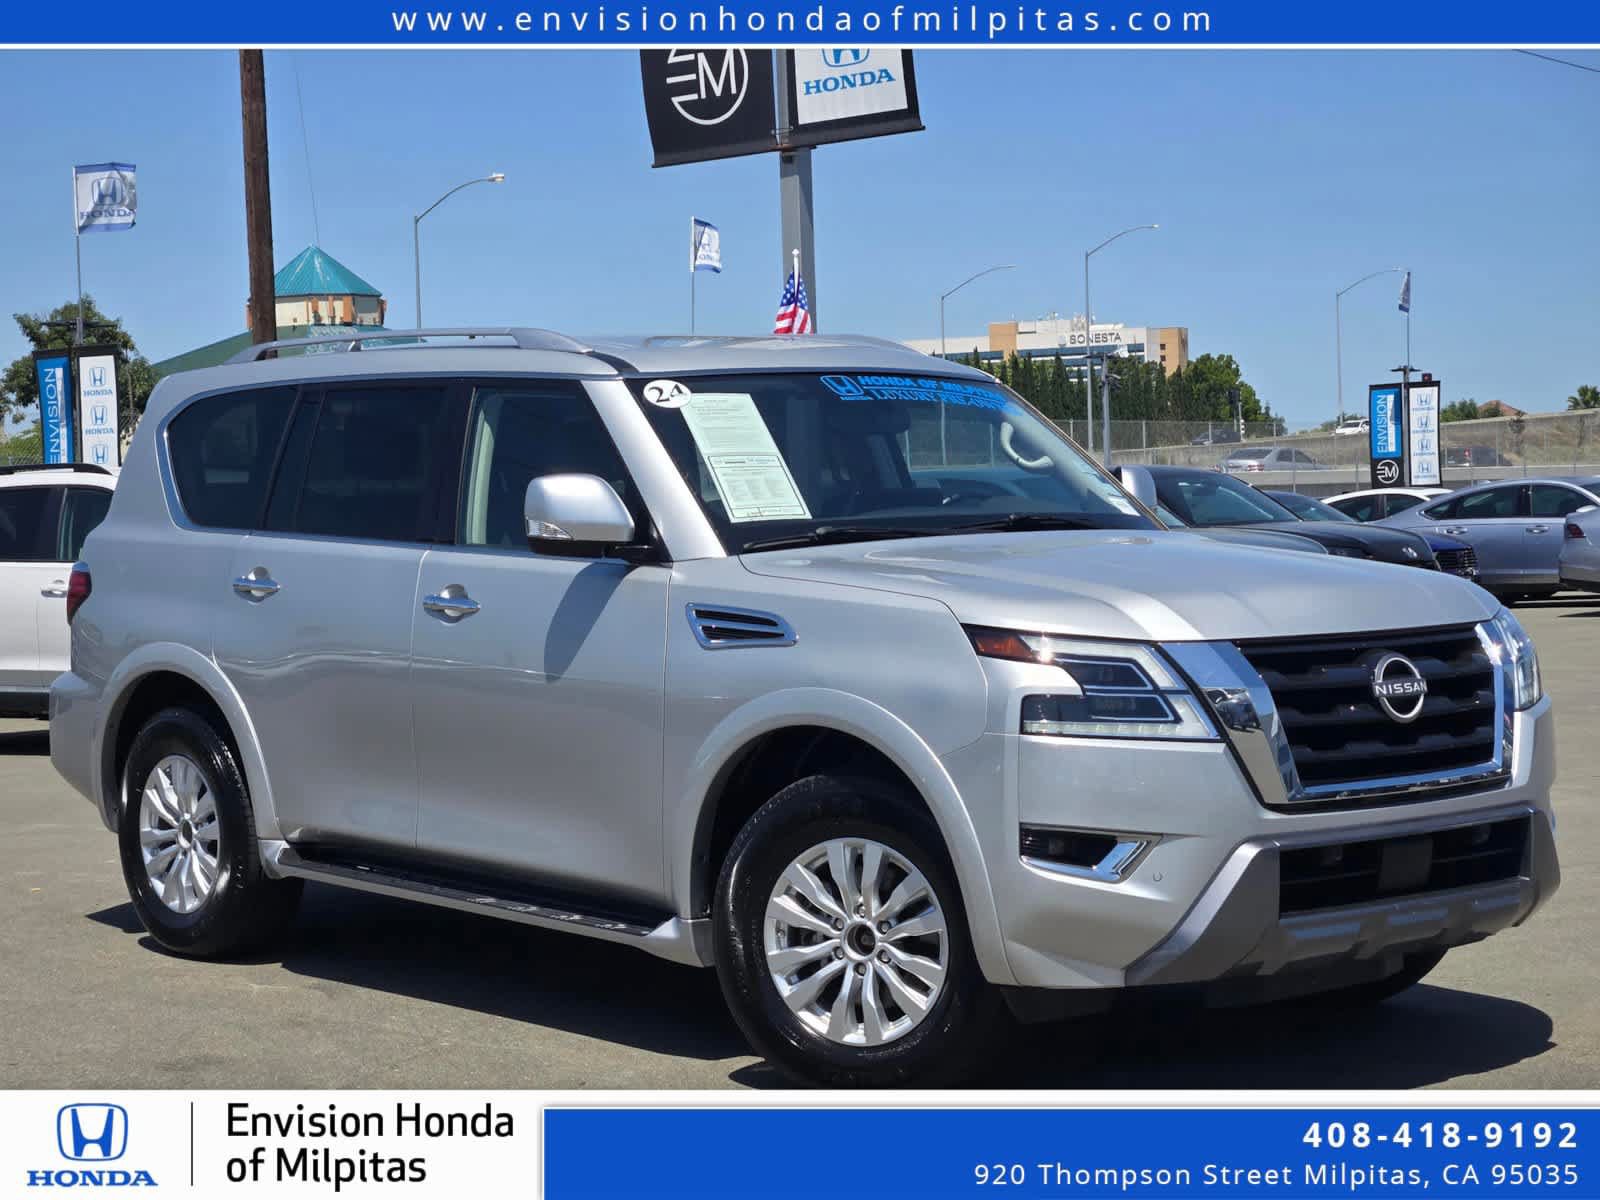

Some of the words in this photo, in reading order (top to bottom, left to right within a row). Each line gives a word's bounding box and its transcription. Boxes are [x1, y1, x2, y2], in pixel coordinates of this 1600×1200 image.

[803, 68, 896, 96] HONDA
[1069, 332, 1122, 345] SONESTA
[857, 375, 918, 388] HONDA
[648, 383, 685, 403] 24
[1376, 394, 1388, 453] ENVISION
[1374, 681, 1427, 696] NISSAN
